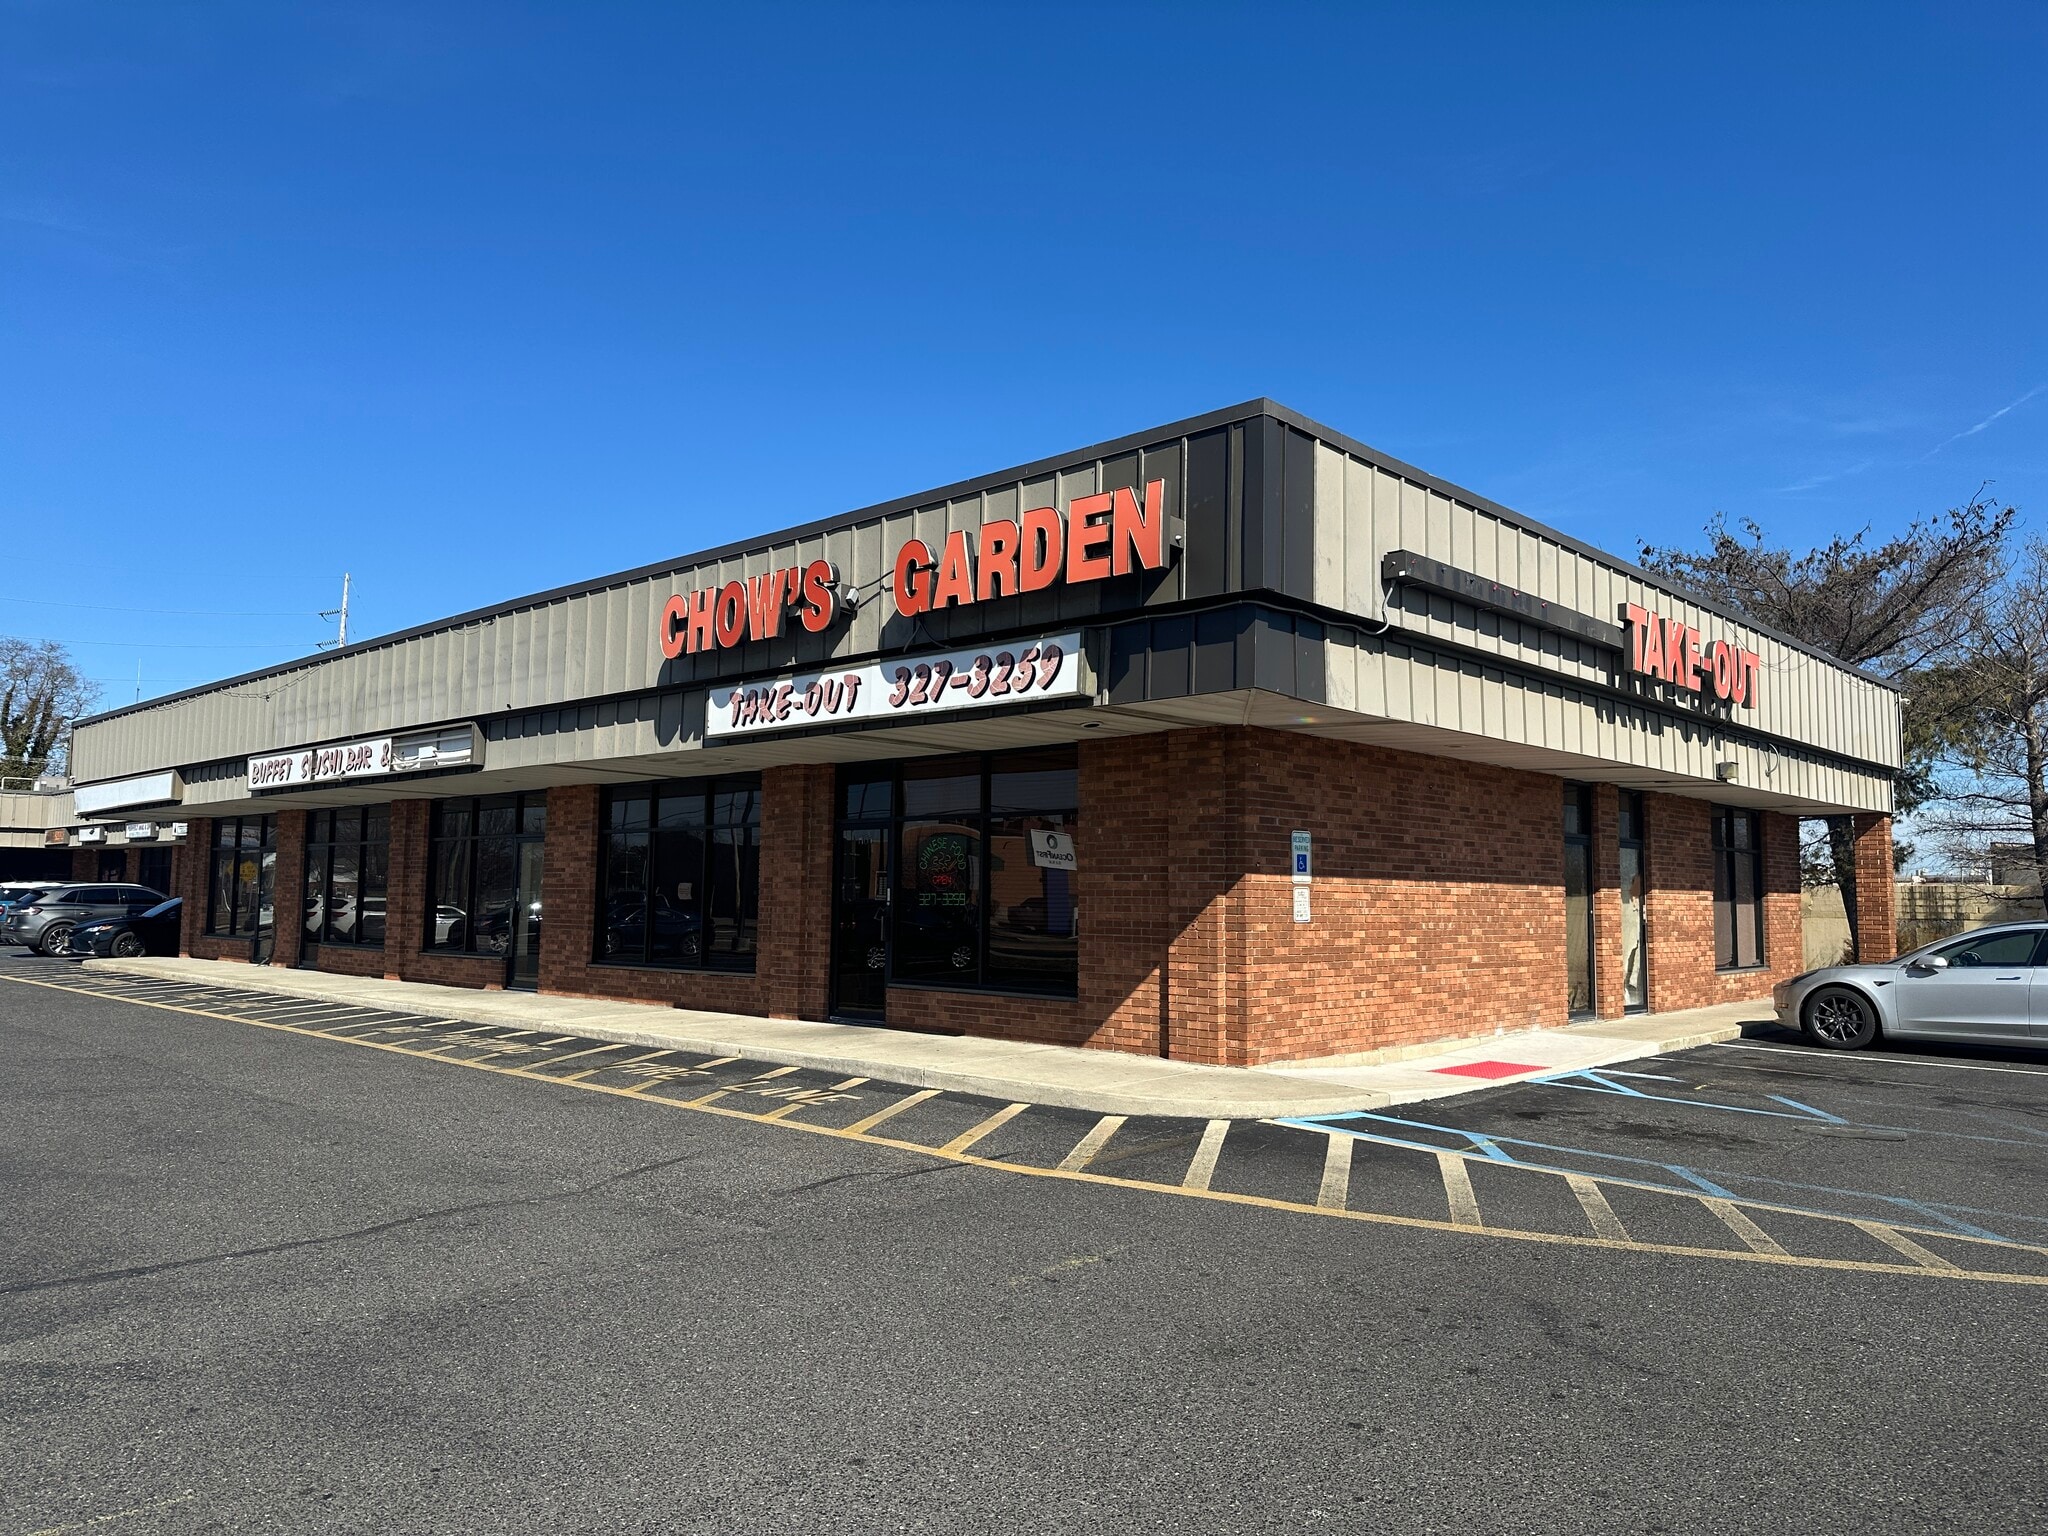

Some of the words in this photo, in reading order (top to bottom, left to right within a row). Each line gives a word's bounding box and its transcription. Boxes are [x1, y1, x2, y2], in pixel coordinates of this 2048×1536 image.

[660, 559, 839, 660] CHOW'S
[893, 477, 1168, 618] GARDEN
[729, 674, 862, 728] TAKE-OUT
[889, 644, 1063, 709] 327-3259
[1620, 602, 1760, 709] TAKE-OUT
[252, 757, 293, 784] BUFFET
[301, 749, 343, 779] SUSHI
[346, 745, 373, 772] BAR
[381, 743, 390, 768] &
[919, 838, 948, 870] CHINESE
[949, 841, 967, 870] FOOD
